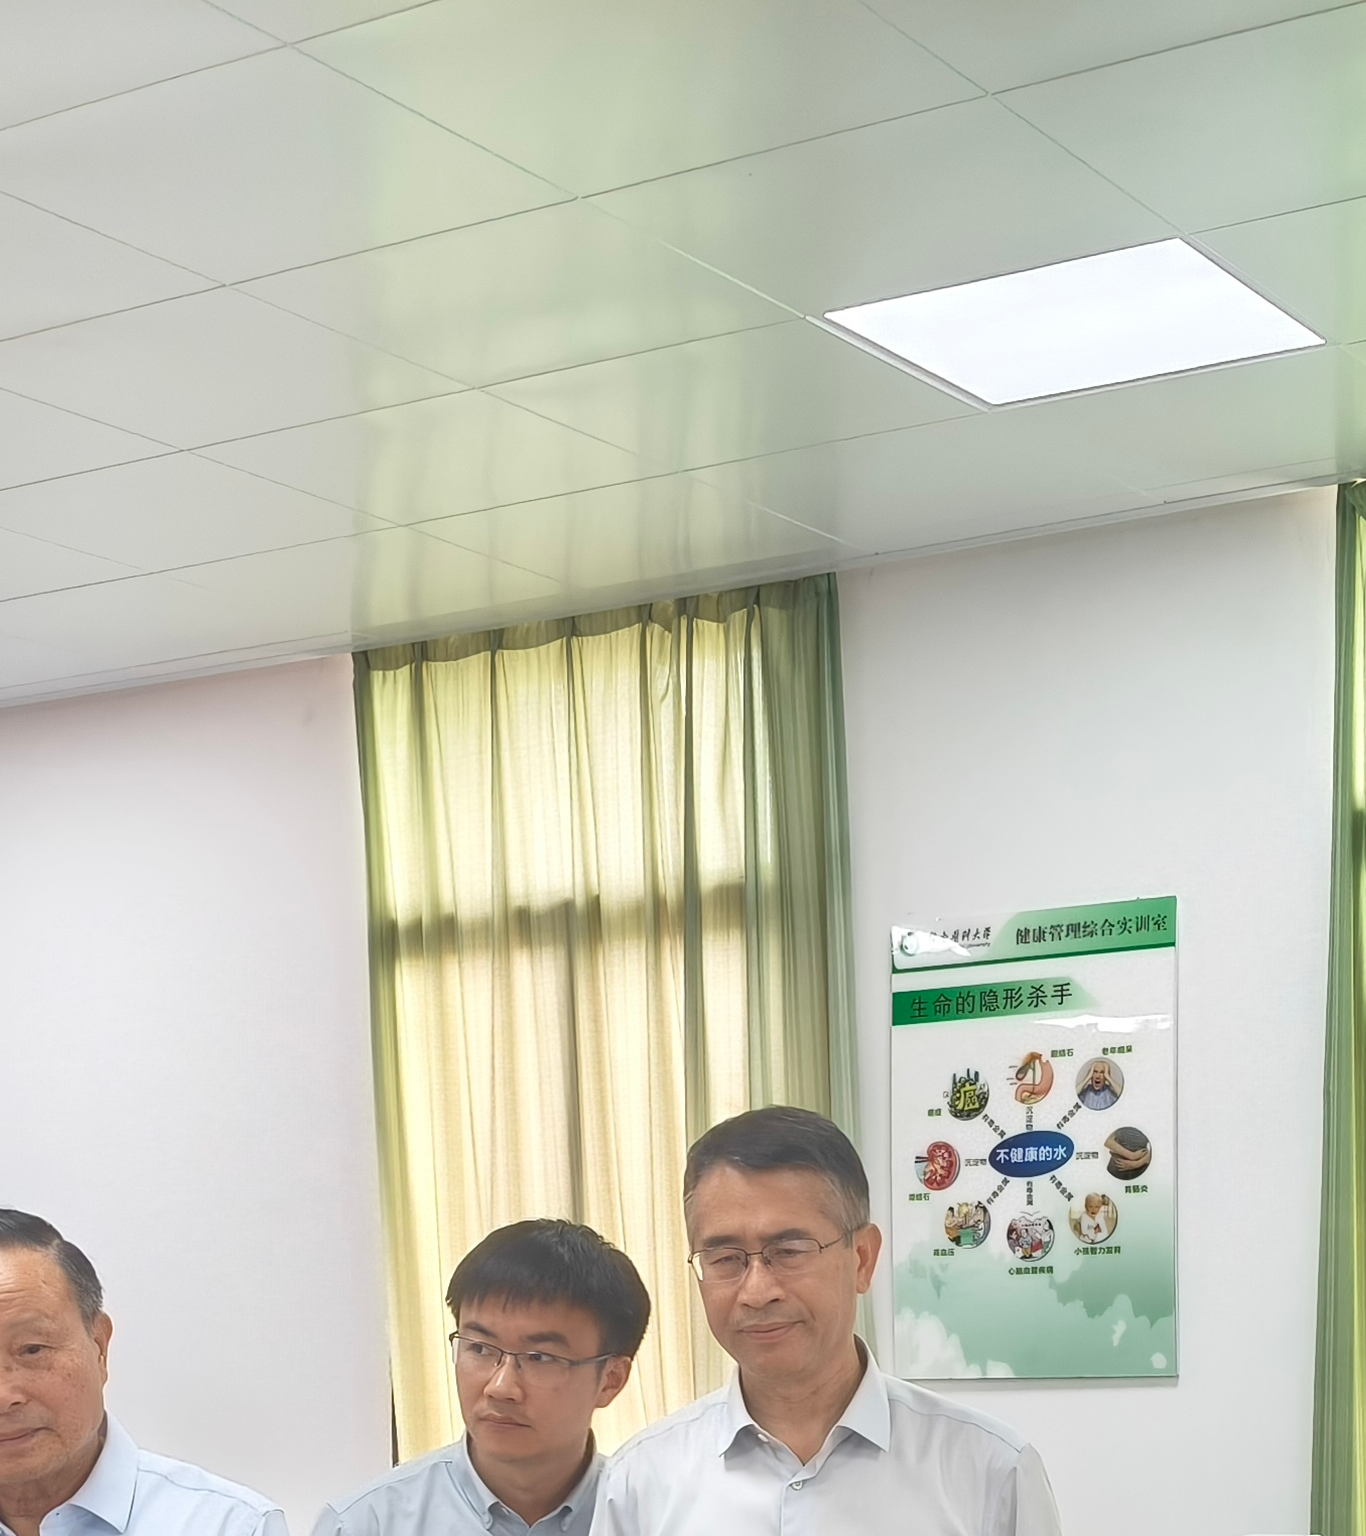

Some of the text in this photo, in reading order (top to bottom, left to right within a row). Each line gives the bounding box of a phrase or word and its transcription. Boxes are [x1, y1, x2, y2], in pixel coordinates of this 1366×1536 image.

[1015, 913, 1168, 945] 健康管理综合实训室
[910, 982, 1073, 1019] 生命的隐形杀手
[996, 1144, 1067, 1164] 不健康的水
